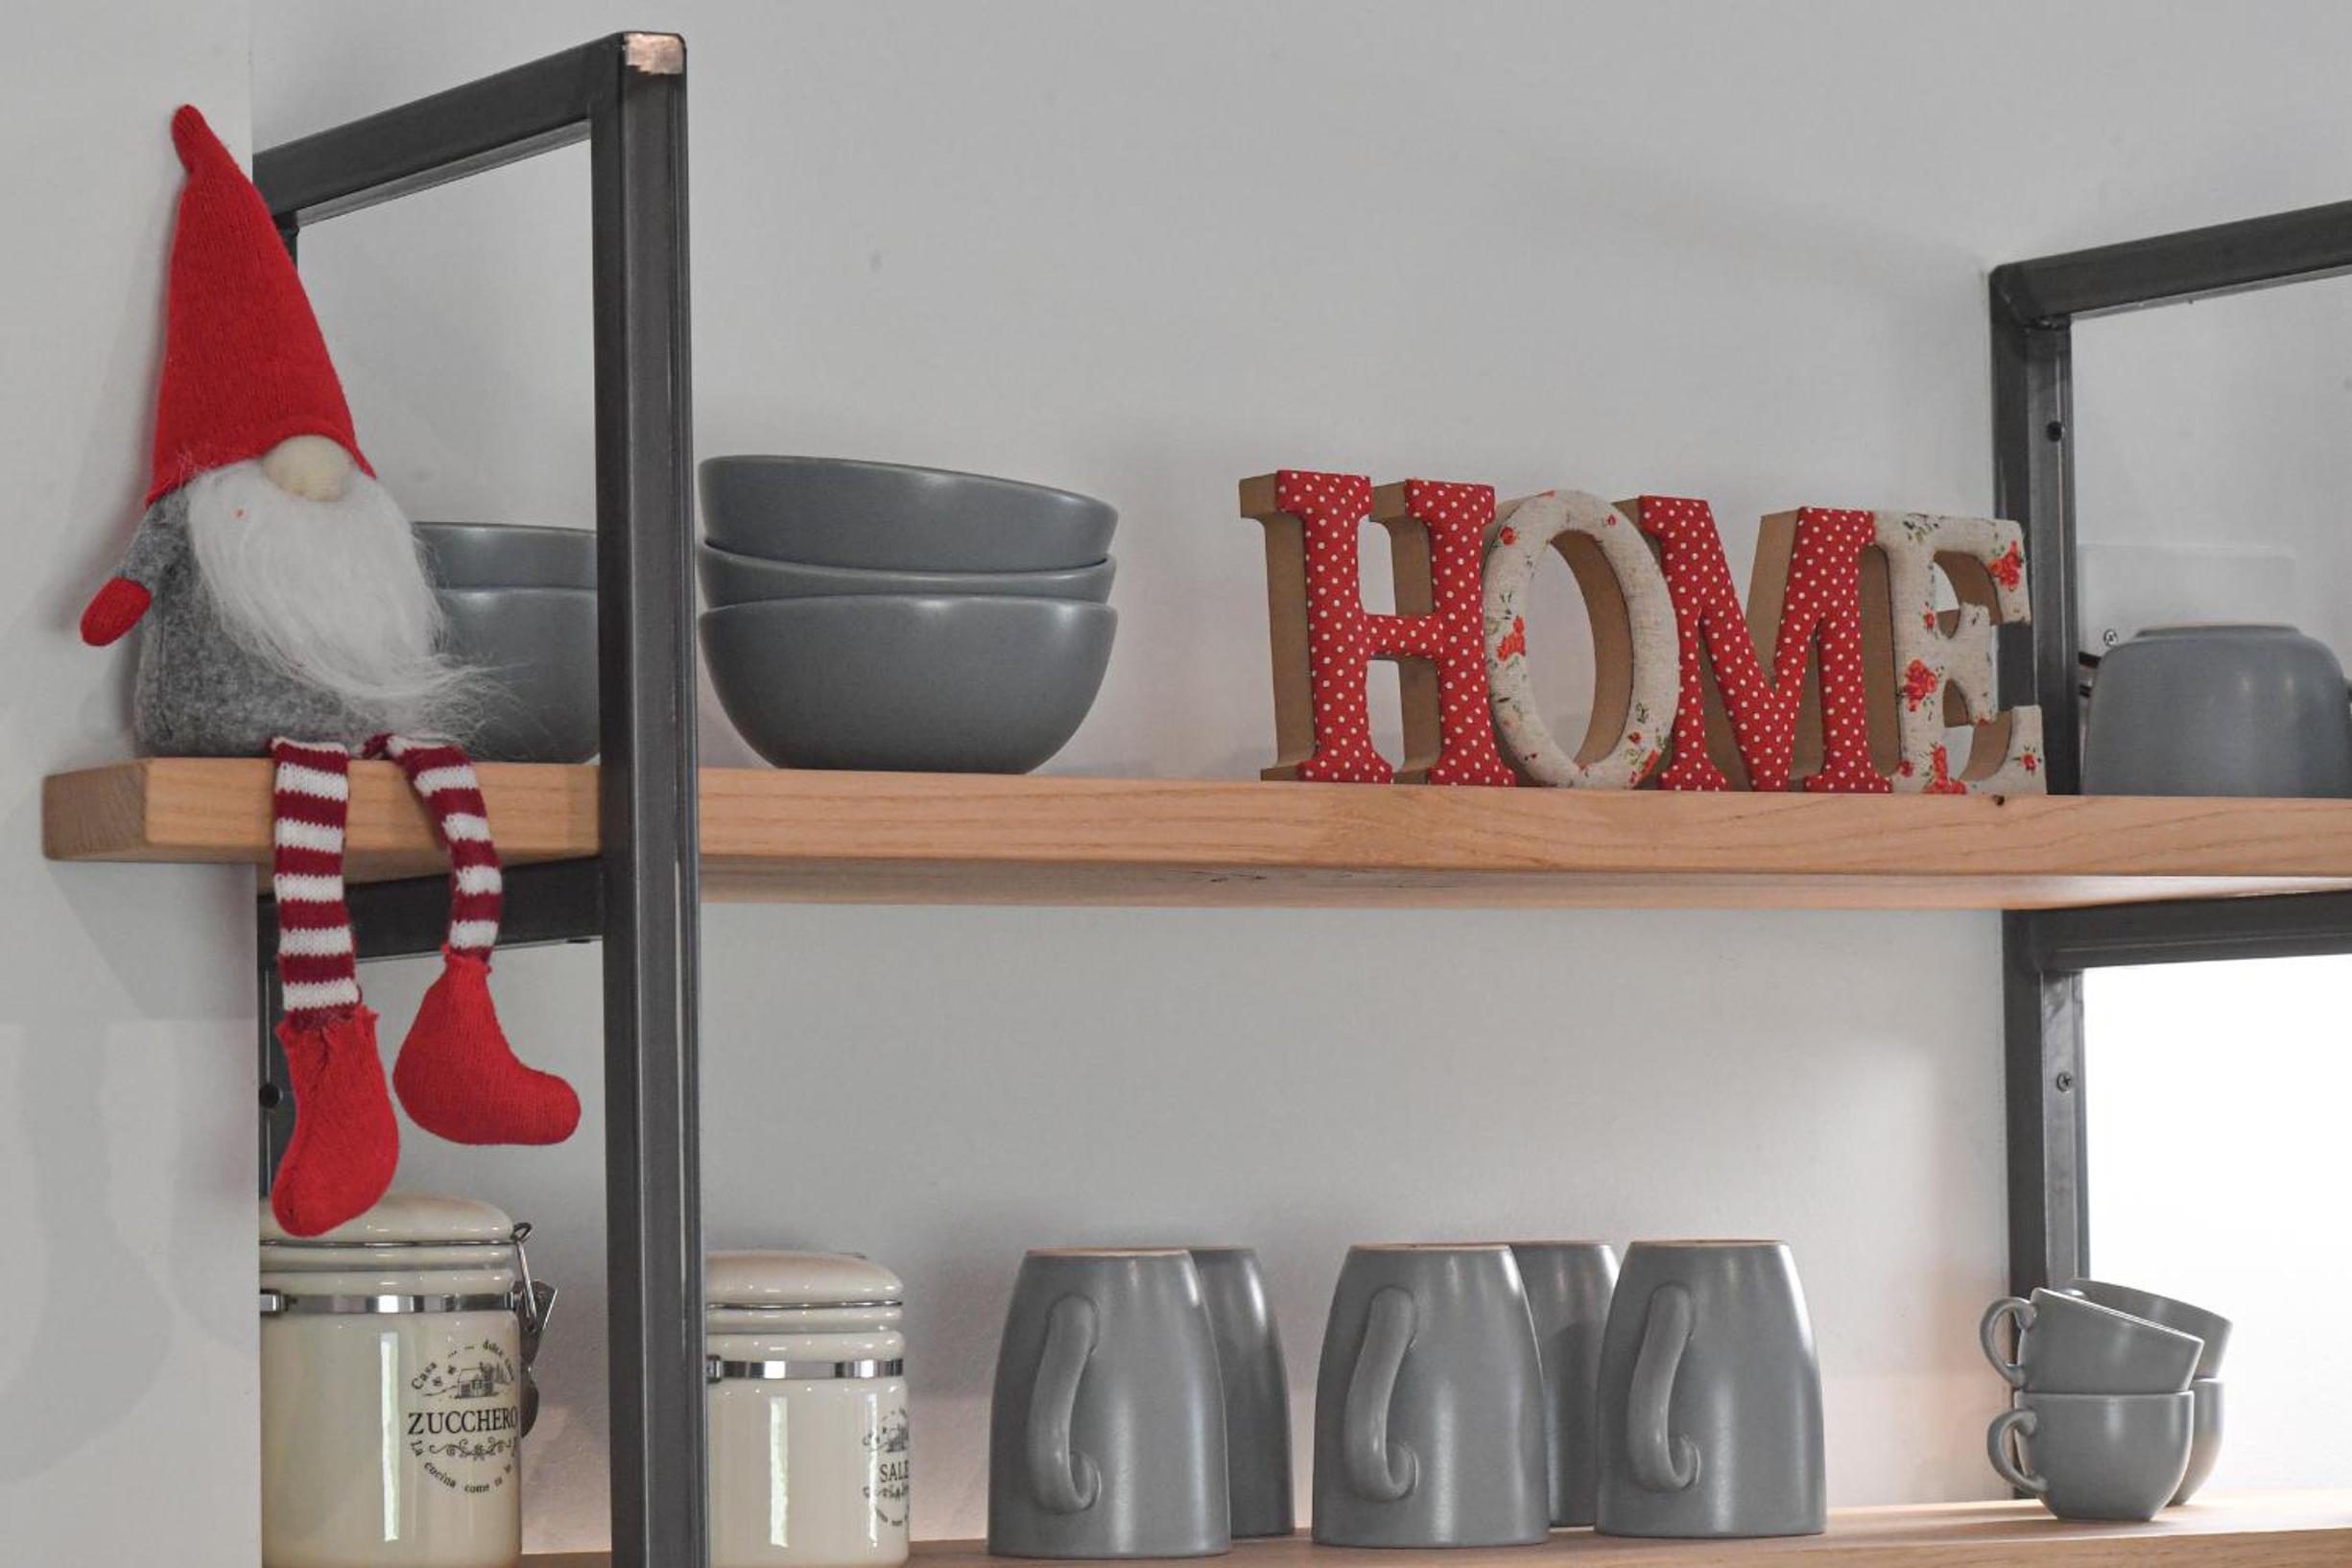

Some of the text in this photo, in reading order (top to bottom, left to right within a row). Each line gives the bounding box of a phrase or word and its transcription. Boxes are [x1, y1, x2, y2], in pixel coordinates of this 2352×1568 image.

[1247, 469, 2049, 795] HOME
[412, 1361, 438, 1390] Casa
[408, 1406, 517, 1436] ZUCCHERO
[424, 1461, 457, 1489] cucina
